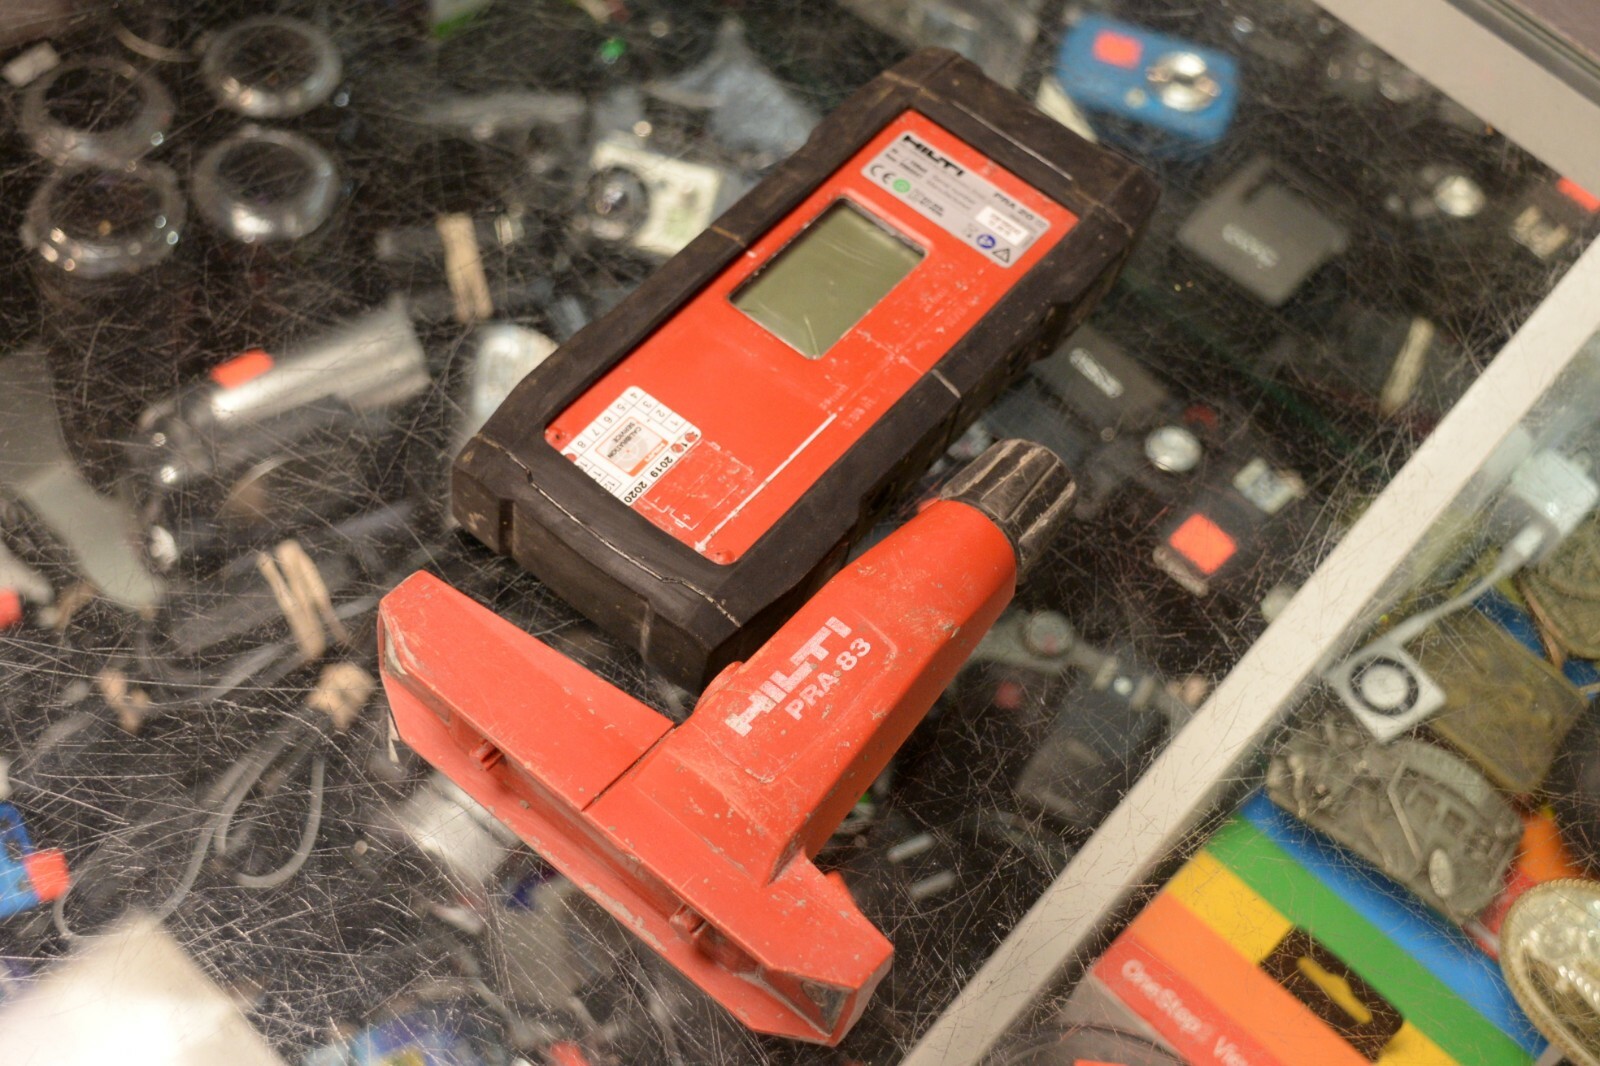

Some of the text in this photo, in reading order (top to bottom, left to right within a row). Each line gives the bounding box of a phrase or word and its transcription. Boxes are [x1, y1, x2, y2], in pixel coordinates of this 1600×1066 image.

[902, 135, 964, 177] HILTI
[616, 403, 626, 412] 5
[655, 409, 666, 418] 2
[576, 440, 587, 449] 8
[649, 455, 674, 479] 2019
[623, 479, 649, 504] 2020
[724, 616, 852, 737] HILTI
[784, 637, 872, 721] PRA 83
